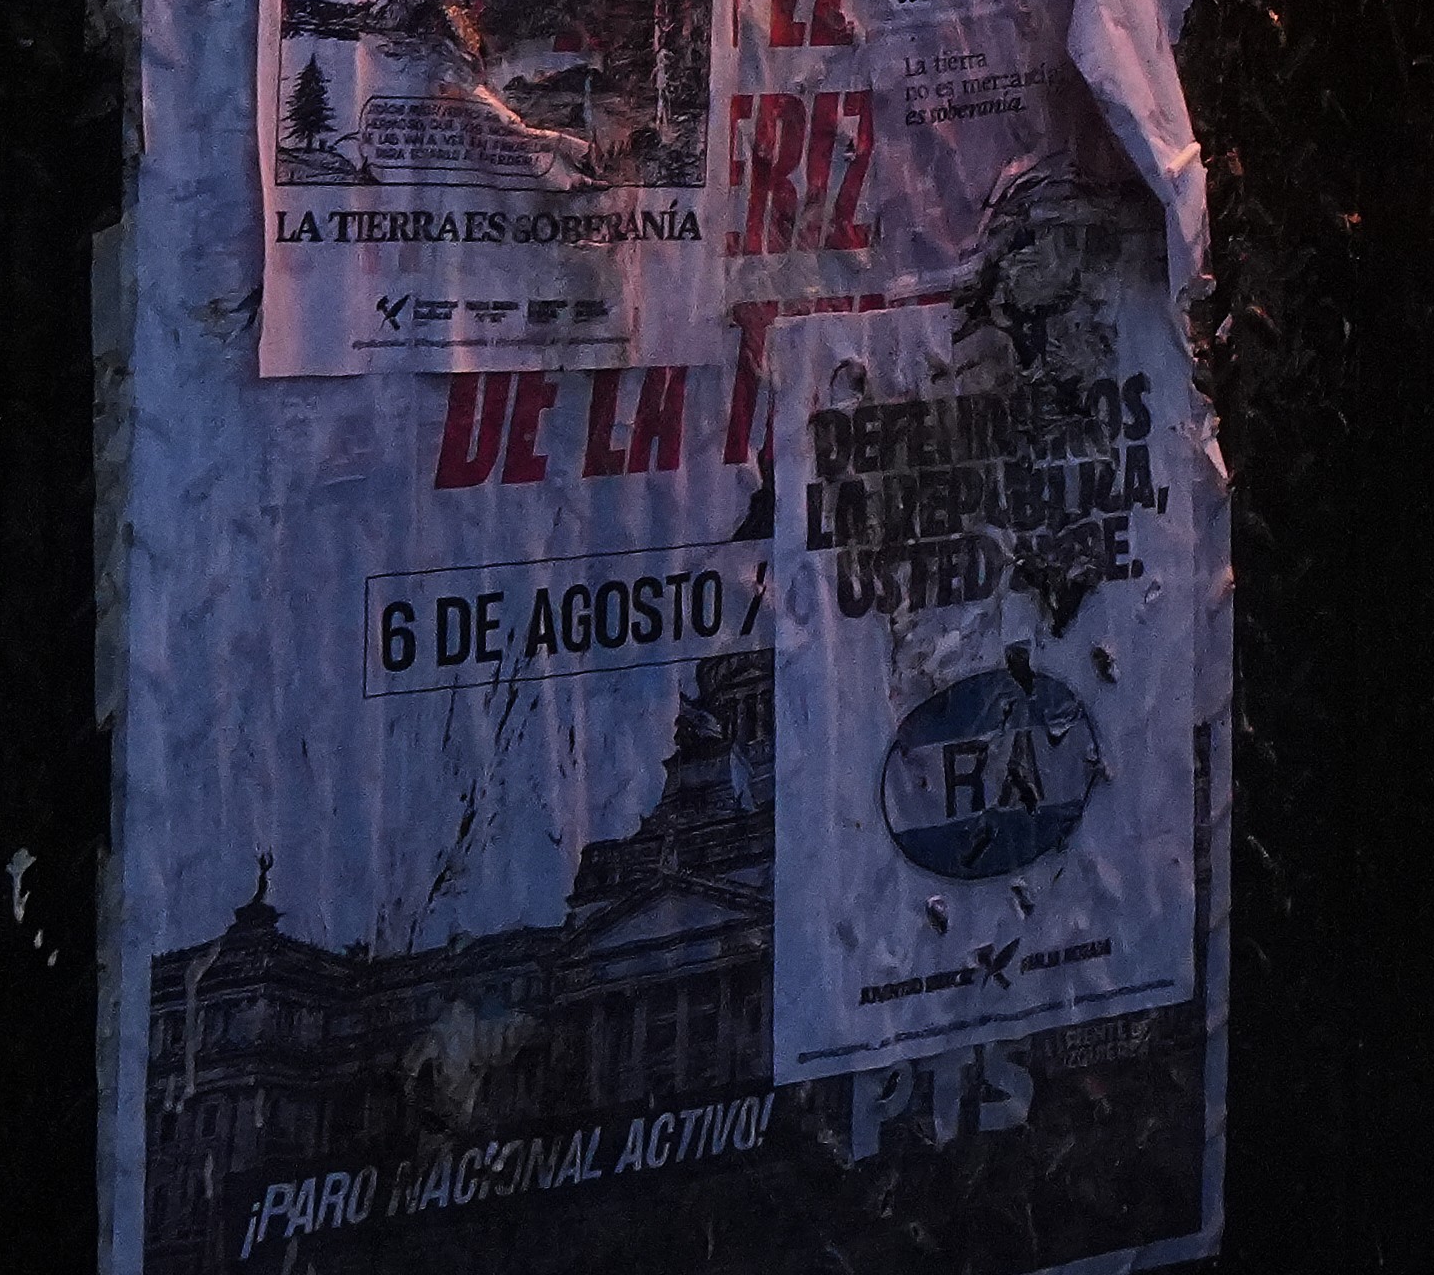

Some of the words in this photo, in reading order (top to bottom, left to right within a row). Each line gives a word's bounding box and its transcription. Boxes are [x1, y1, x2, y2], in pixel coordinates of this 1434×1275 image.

[276, 210, 323, 243] LA
[328, 209, 460, 244] TIERRA
[463, 211, 507, 243] ES
[512, 198, 702, 244] SOBERANÍA
[380, 599, 417, 672] 6
[436, 590, 504, 667] DE
[525, 568, 723, 658] AGOSTO
[850, 1039, 1036, 1160] PTS
[239, 1166, 378, 1260] ¡PARO
[387, 1126, 603, 1218] NACIONAL
[614, 1092, 778, 1175] ACTIVO!
